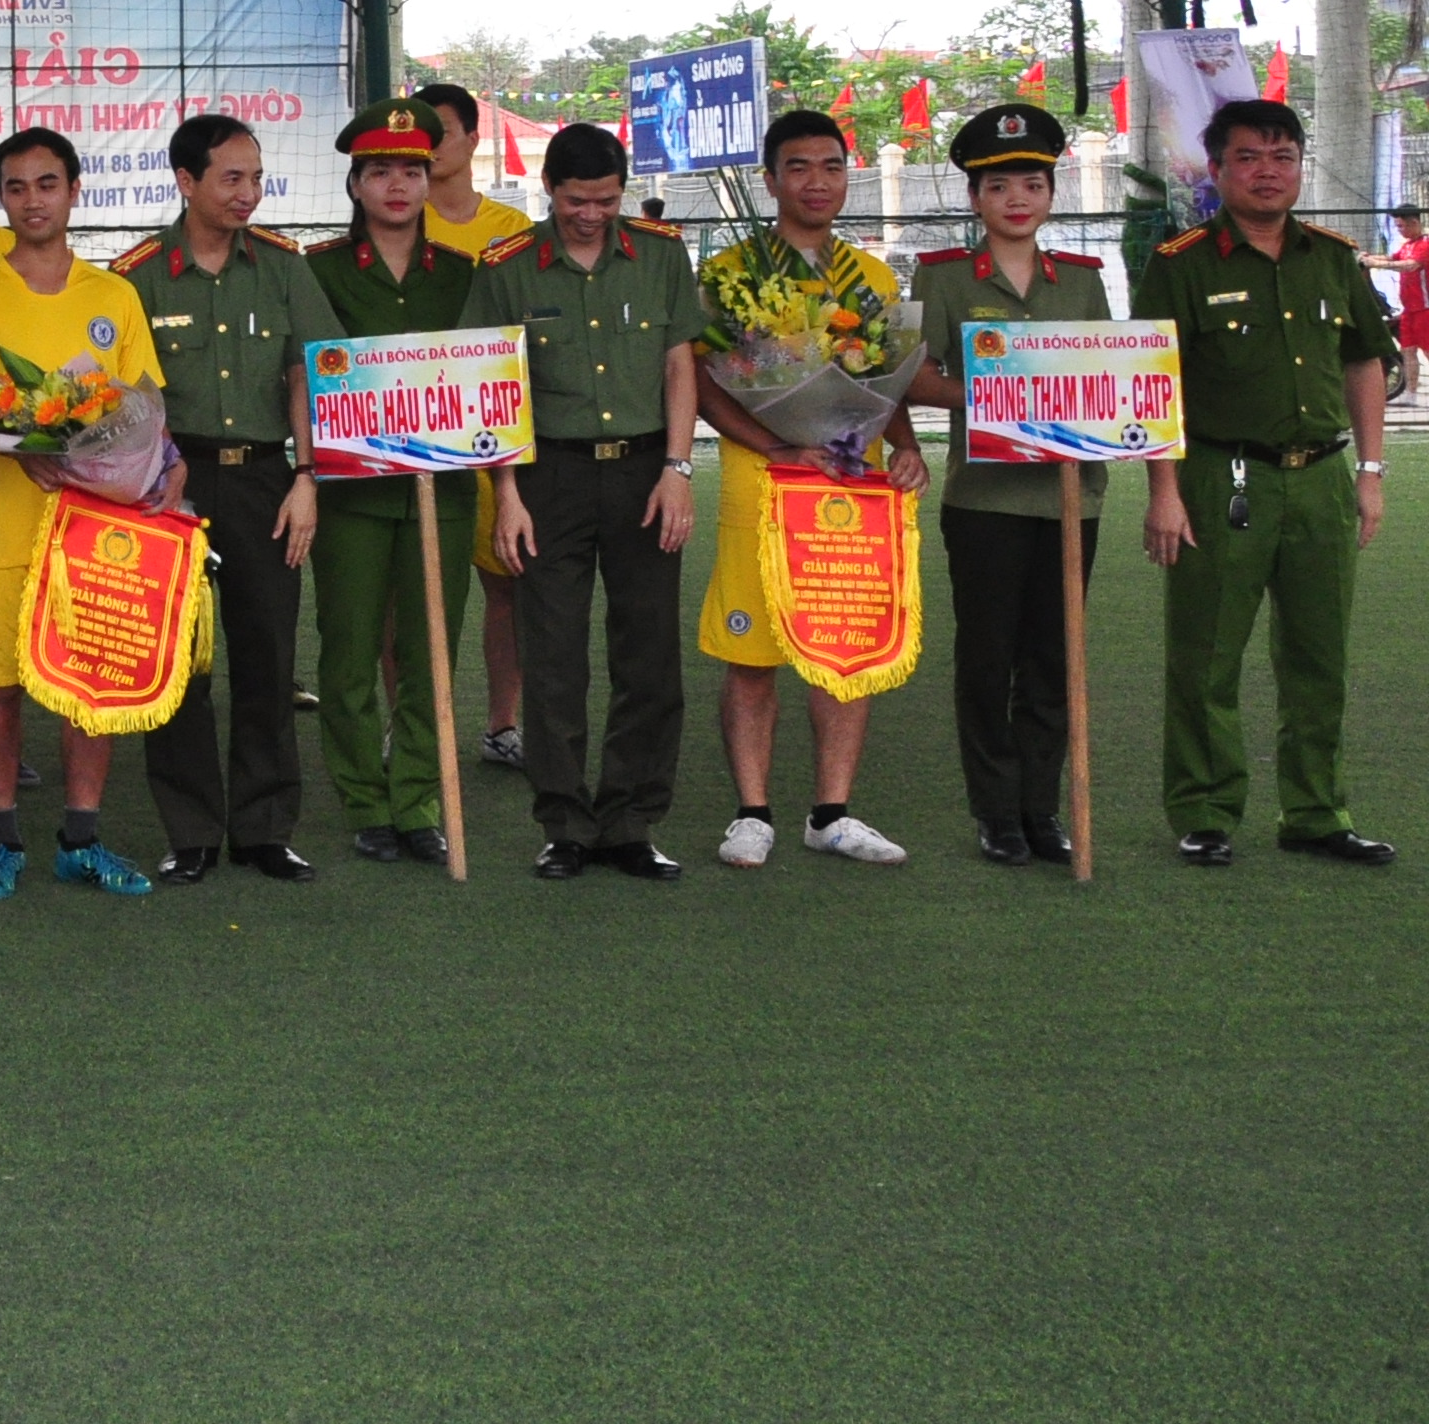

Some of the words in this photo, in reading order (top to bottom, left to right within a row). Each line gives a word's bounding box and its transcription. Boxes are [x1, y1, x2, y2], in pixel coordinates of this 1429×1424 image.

[691, 57, 712, 83] SÂN
[713, 53, 744, 79] BÓNG
[724, 92, 754, 155] LÂM
[355, 347, 384, 365] GIẢI
[387, 346, 426, 363] BÓNG
[429, 343, 448, 359] ĐÁ
[450, 343, 484, 358] GIAO
[487, 339, 516, 355] HỮU
[1012, 334, 1039, 350] GIẢI
[1042, 333, 1081, 349] BÓNG
[1083, 333, 1101, 349] ĐÁ
[1103, 336, 1137, 349] GIAO
[1140, 333, 1169, 348] HỮU
[316, 381, 379, 441] PHÒNG
[383, 378, 420, 445] HẬU
[424, 369, 463, 432] CẦN
[479, 380, 522, 427] CATP
[973, 364, 1027, 422] PHÒNG
[1031, 374, 1077, 421] THAM
[1082, 370, 1117, 421] MƯU
[1132, 374, 1173, 420] CATP
[802, 557, 827, 574] GIẢI
[829, 560, 862, 575] BÓNG
[96, 593, 129, 612] BÓNG
